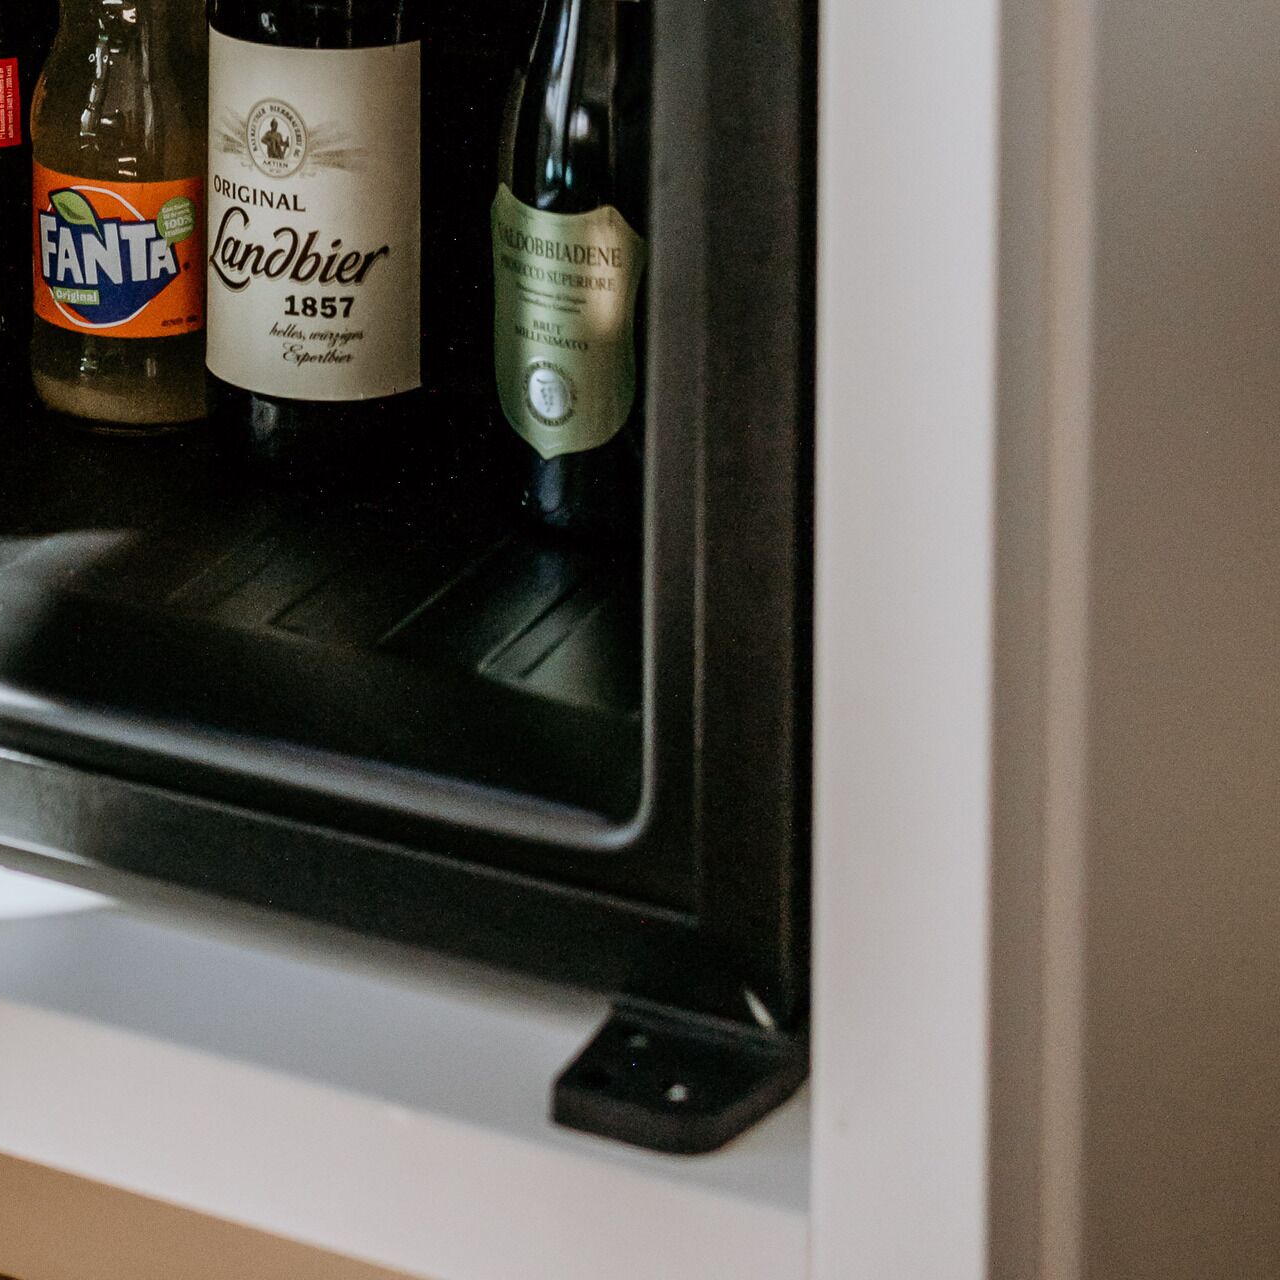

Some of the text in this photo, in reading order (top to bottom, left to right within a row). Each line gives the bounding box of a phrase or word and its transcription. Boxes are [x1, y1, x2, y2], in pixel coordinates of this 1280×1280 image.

[213, 174, 306, 213] ORIGINAL
[39, 213, 178, 286] FANTA
[208, 206, 390, 293] Landbier
[56, 290, 98, 304] Original
[284, 294, 355, 319] 1857
